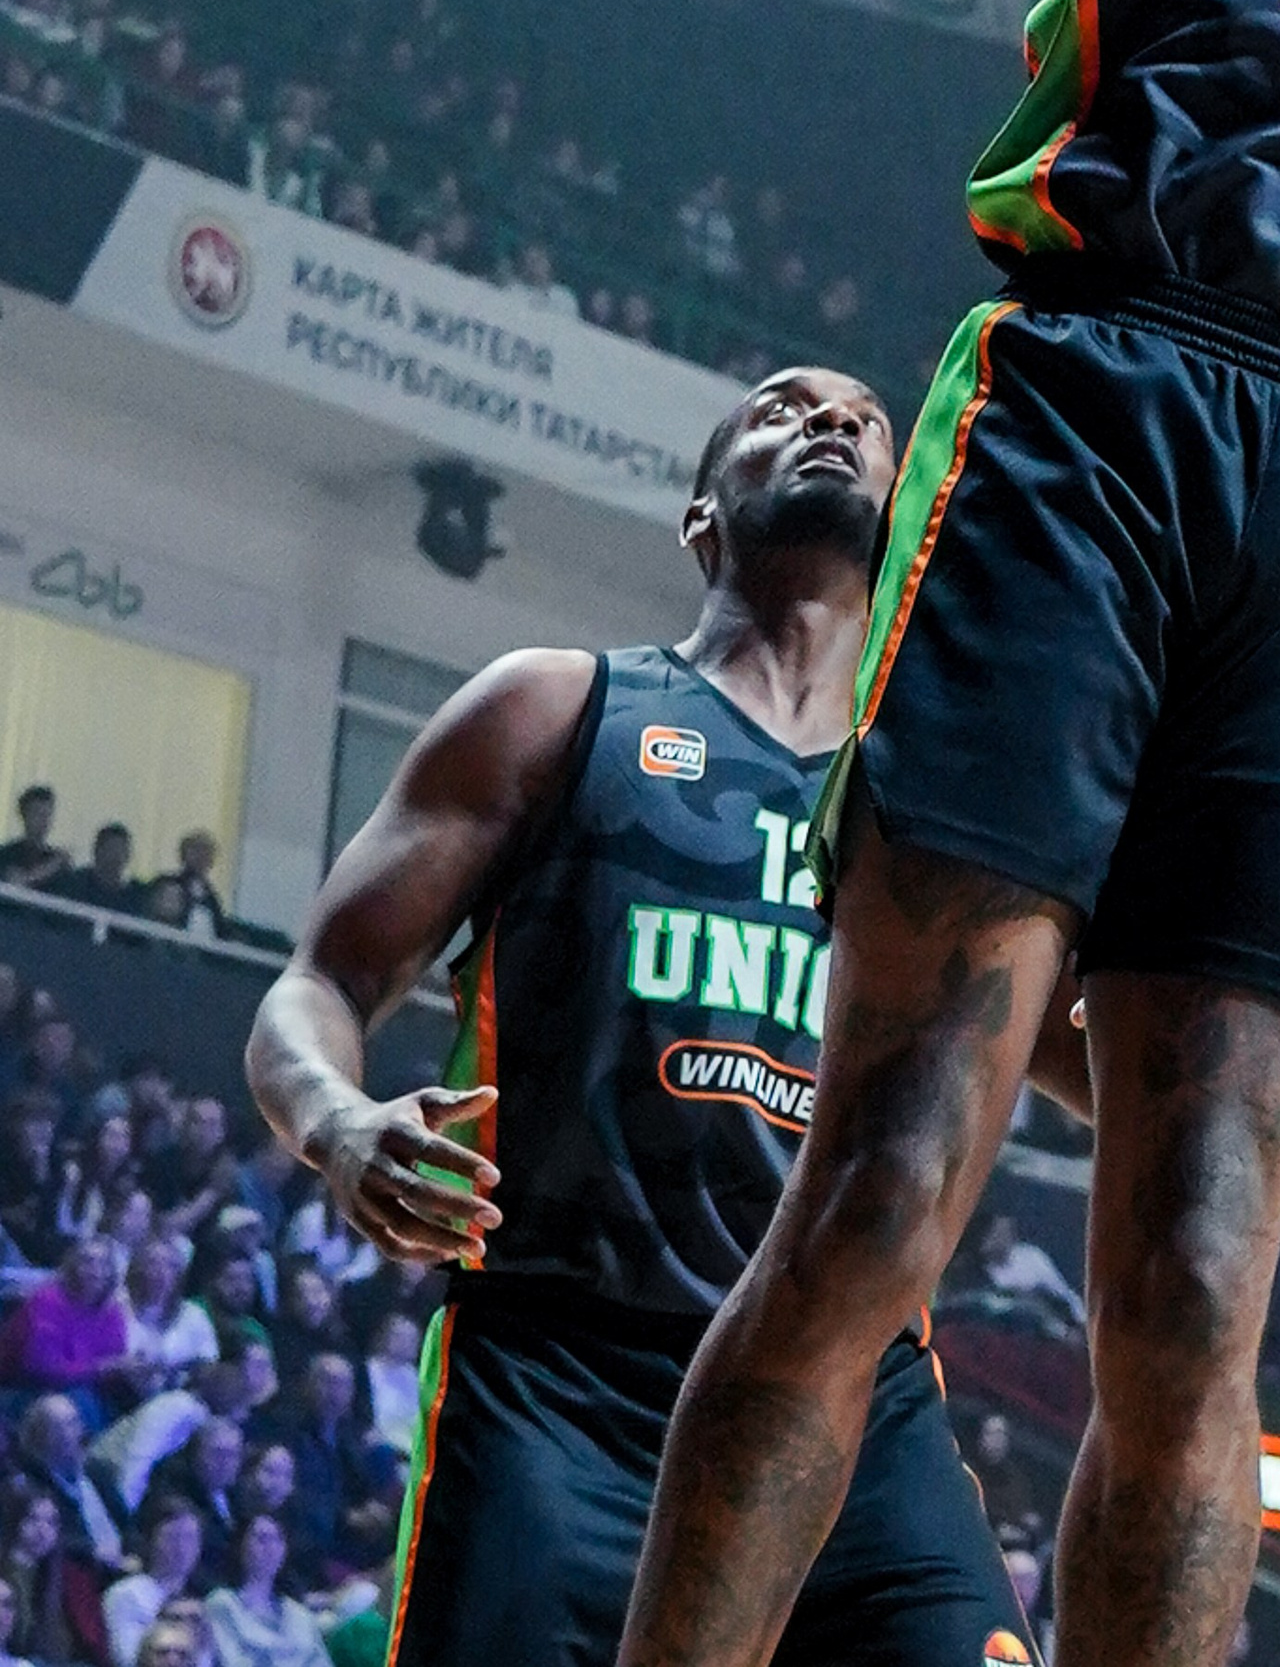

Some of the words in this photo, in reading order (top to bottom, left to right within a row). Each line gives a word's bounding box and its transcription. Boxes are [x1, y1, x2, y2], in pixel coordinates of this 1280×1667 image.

[292, 254, 403, 327] КАРТА
[411, 296, 554, 384] ЖИТЕЛЯ
[286, 309, 522, 430] РЕСПУБЛИКИ
[530, 400, 698, 492] ТАТАРСТА
[656, 740, 700, 764] WIN
[679, 1051, 816, 1121] WINLINE
